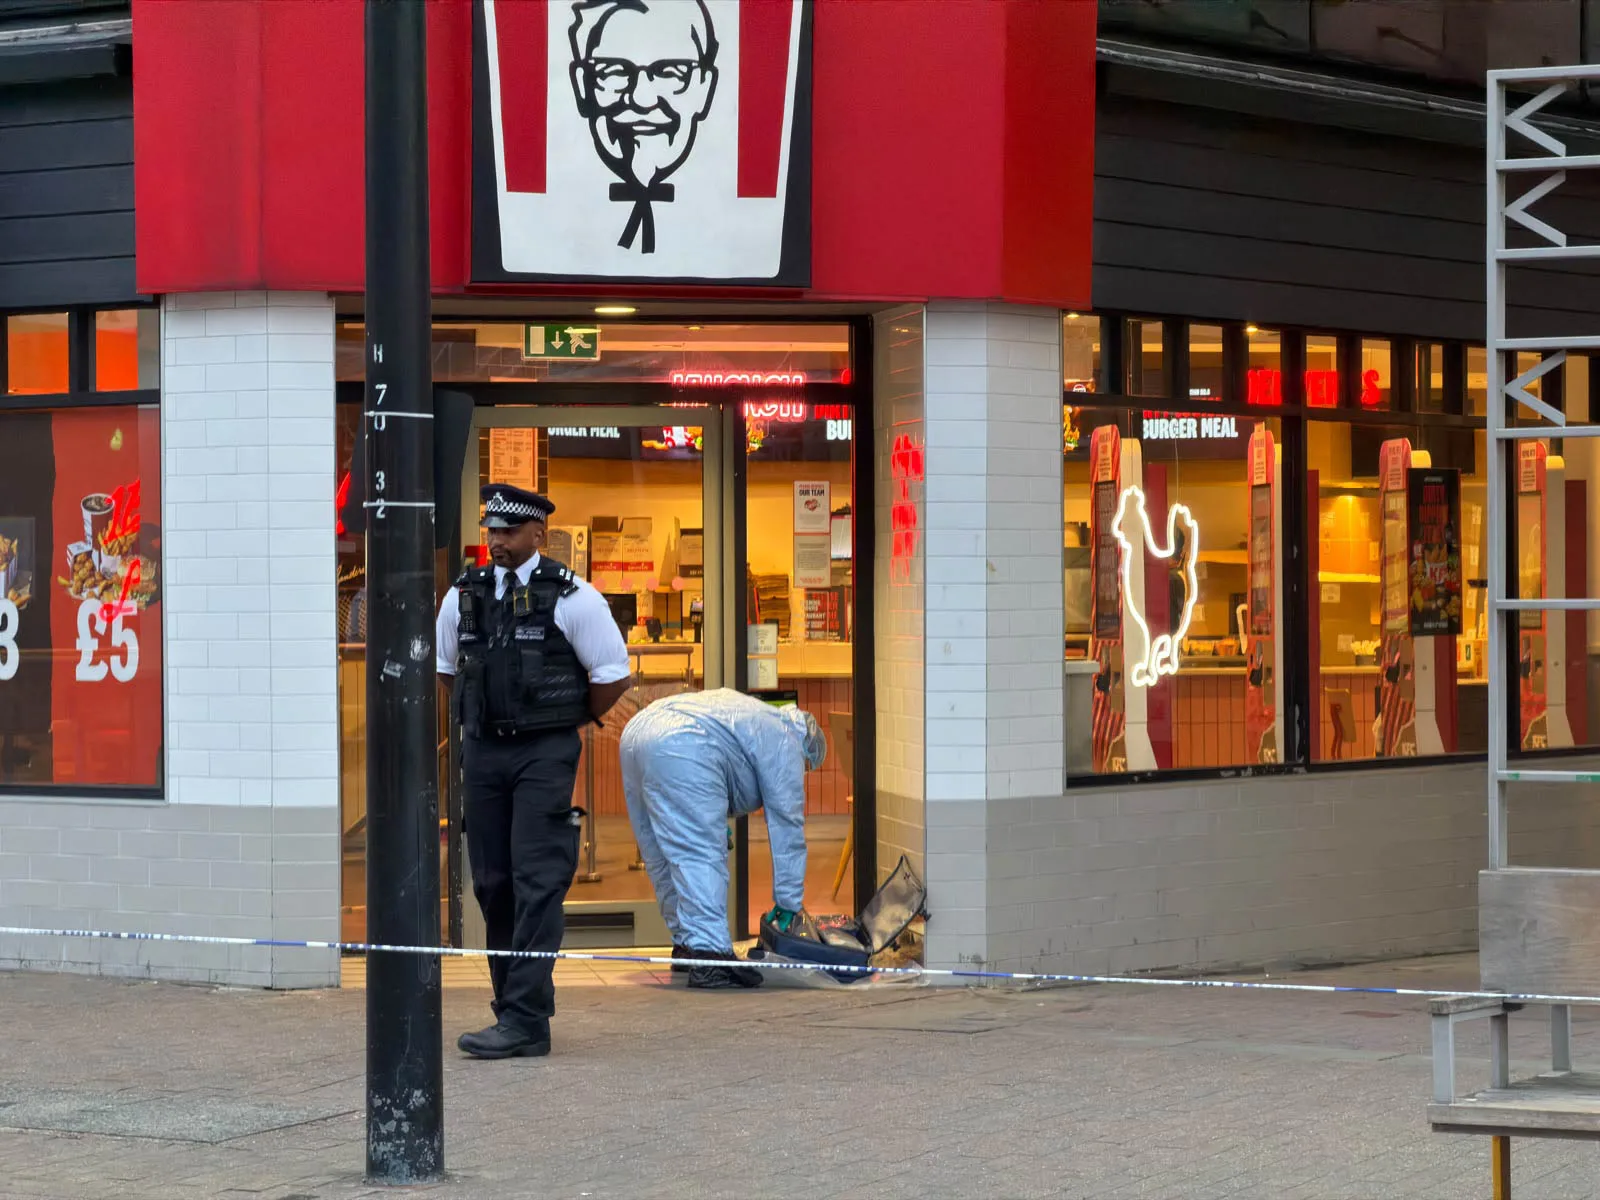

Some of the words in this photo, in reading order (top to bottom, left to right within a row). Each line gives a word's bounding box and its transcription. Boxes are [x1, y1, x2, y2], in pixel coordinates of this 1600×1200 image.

[1200, 416, 1239, 438] MEAL
[812, 489, 825, 497] TEAM
[75, 599, 139, 682] £5
